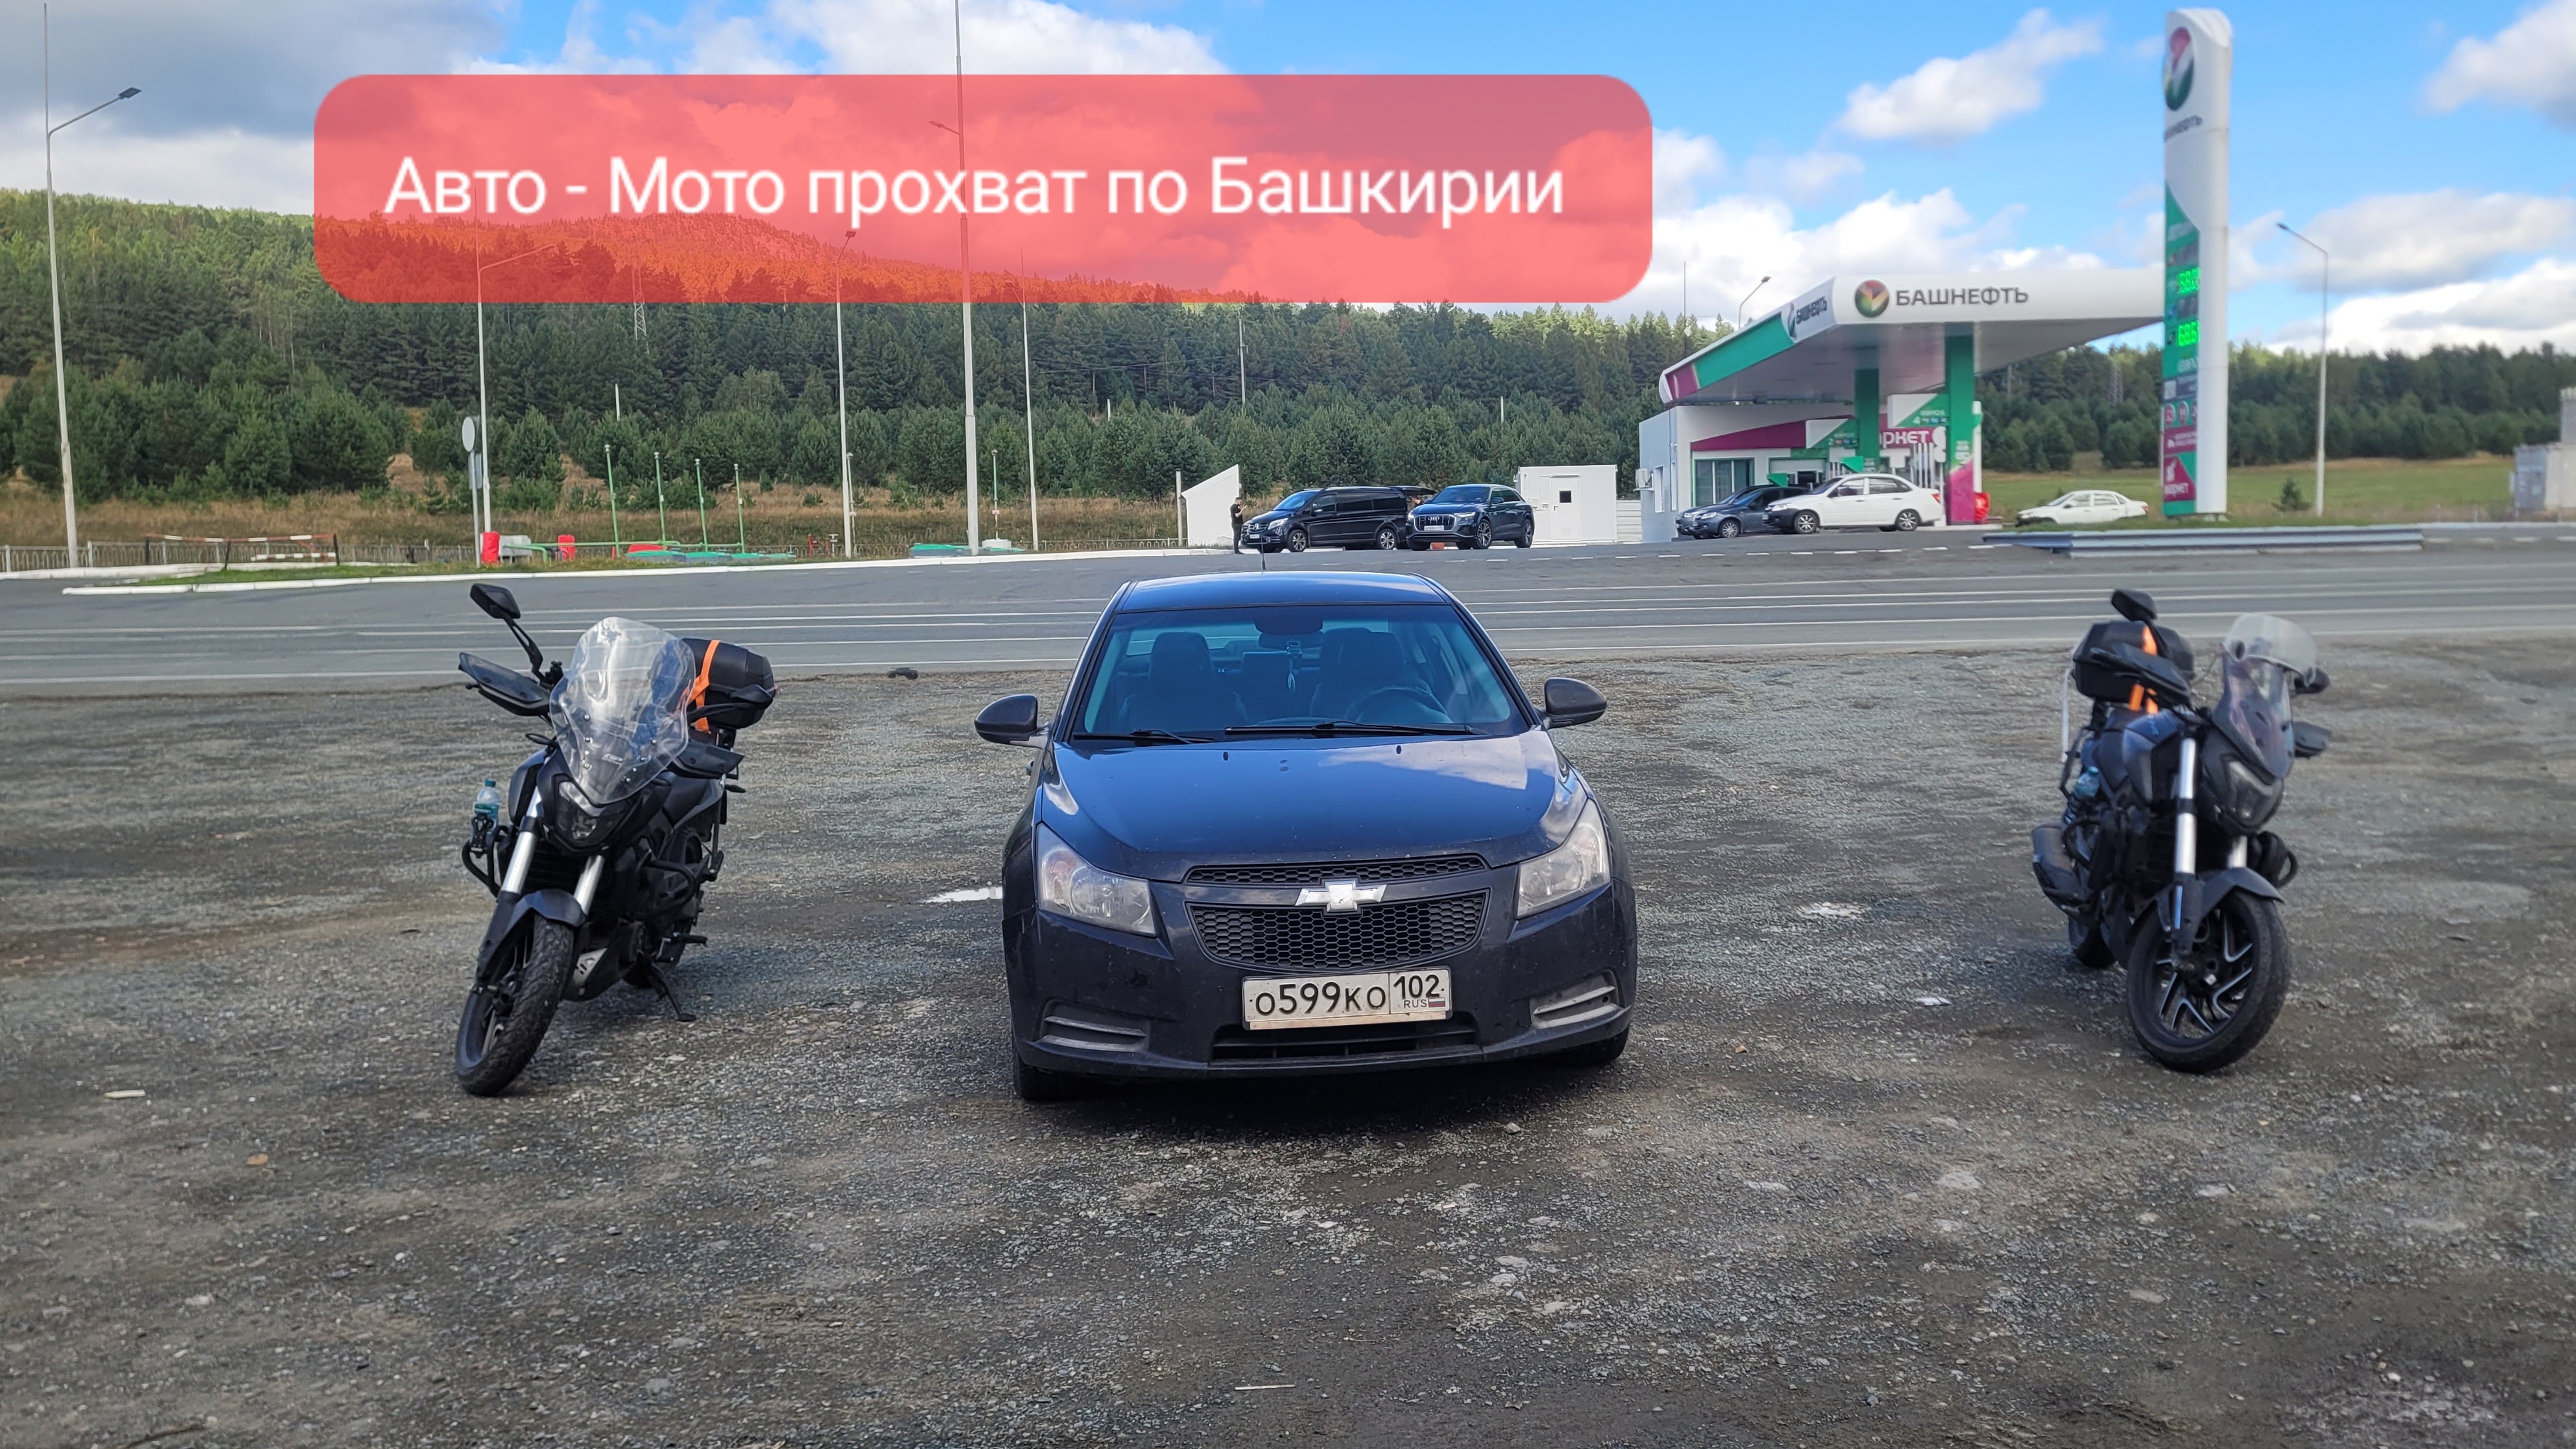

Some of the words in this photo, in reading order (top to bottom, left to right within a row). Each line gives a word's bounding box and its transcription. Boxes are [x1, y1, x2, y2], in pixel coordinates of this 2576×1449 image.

[1895, 285, 2029, 307] БАШНЕФТЬ
[1393, 974, 1440, 999] 102
[1403, 999, 1427, 1009] RUS
